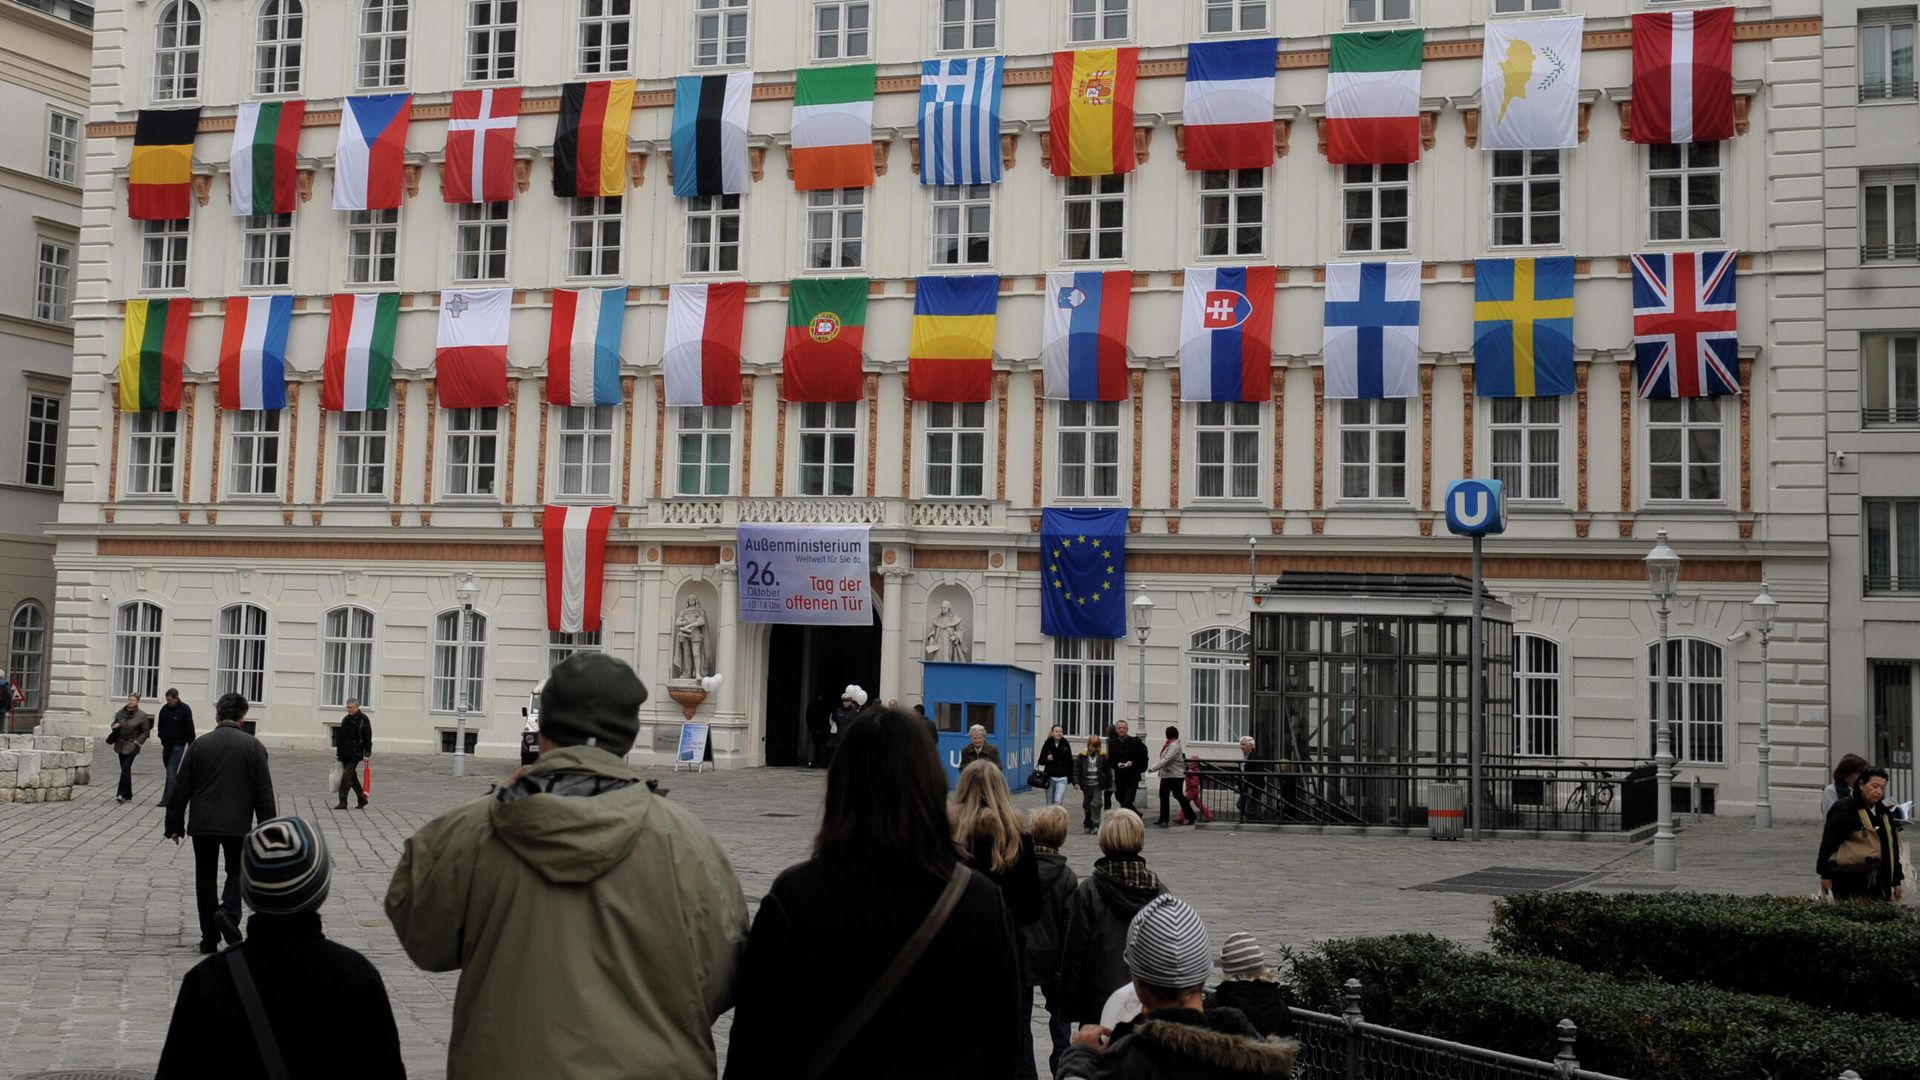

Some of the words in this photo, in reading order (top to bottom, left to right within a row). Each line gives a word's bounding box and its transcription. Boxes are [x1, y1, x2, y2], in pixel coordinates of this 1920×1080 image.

[1455, 491, 1488, 527] U
[745, 538, 861, 553] Außenministerium
[795, 555, 826, 564] Weltweit
[827, 555, 838, 564] für
[839, 555, 851, 564] Sie
[746, 560, 780, 587] 26.
[747, 587, 780, 598] Oktober
[809, 576, 834, 594] Tag
[839, 577, 862, 592] der
[785, 595, 838, 611] offenen
[841, 596, 863, 611] Tür
[950, 750, 962, 768] U
[1007, 752, 1018, 770] UN
[1022, 748, 1032, 765] UN
